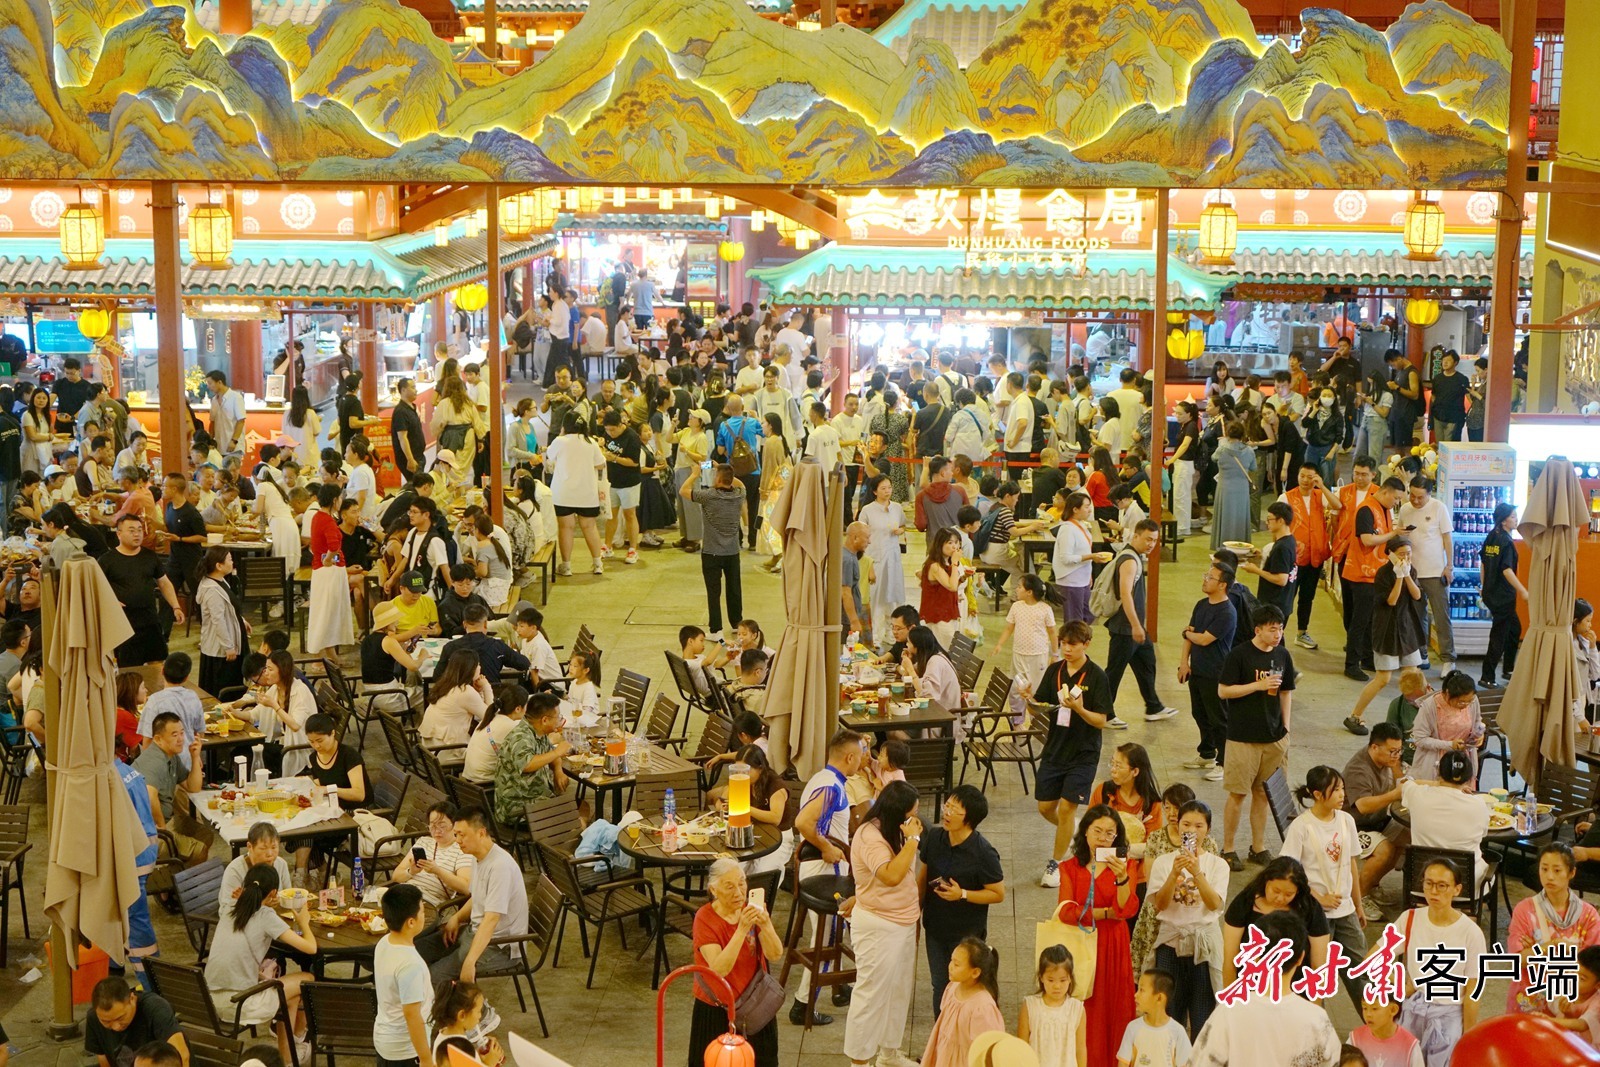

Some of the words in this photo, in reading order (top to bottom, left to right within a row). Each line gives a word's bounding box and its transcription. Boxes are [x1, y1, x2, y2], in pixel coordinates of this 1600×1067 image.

[911, 188, 1142, 231] 敦煌食局
[948, 236, 1043, 249] DUNHUANG
[1051, 237, 1110, 249] FOODS
